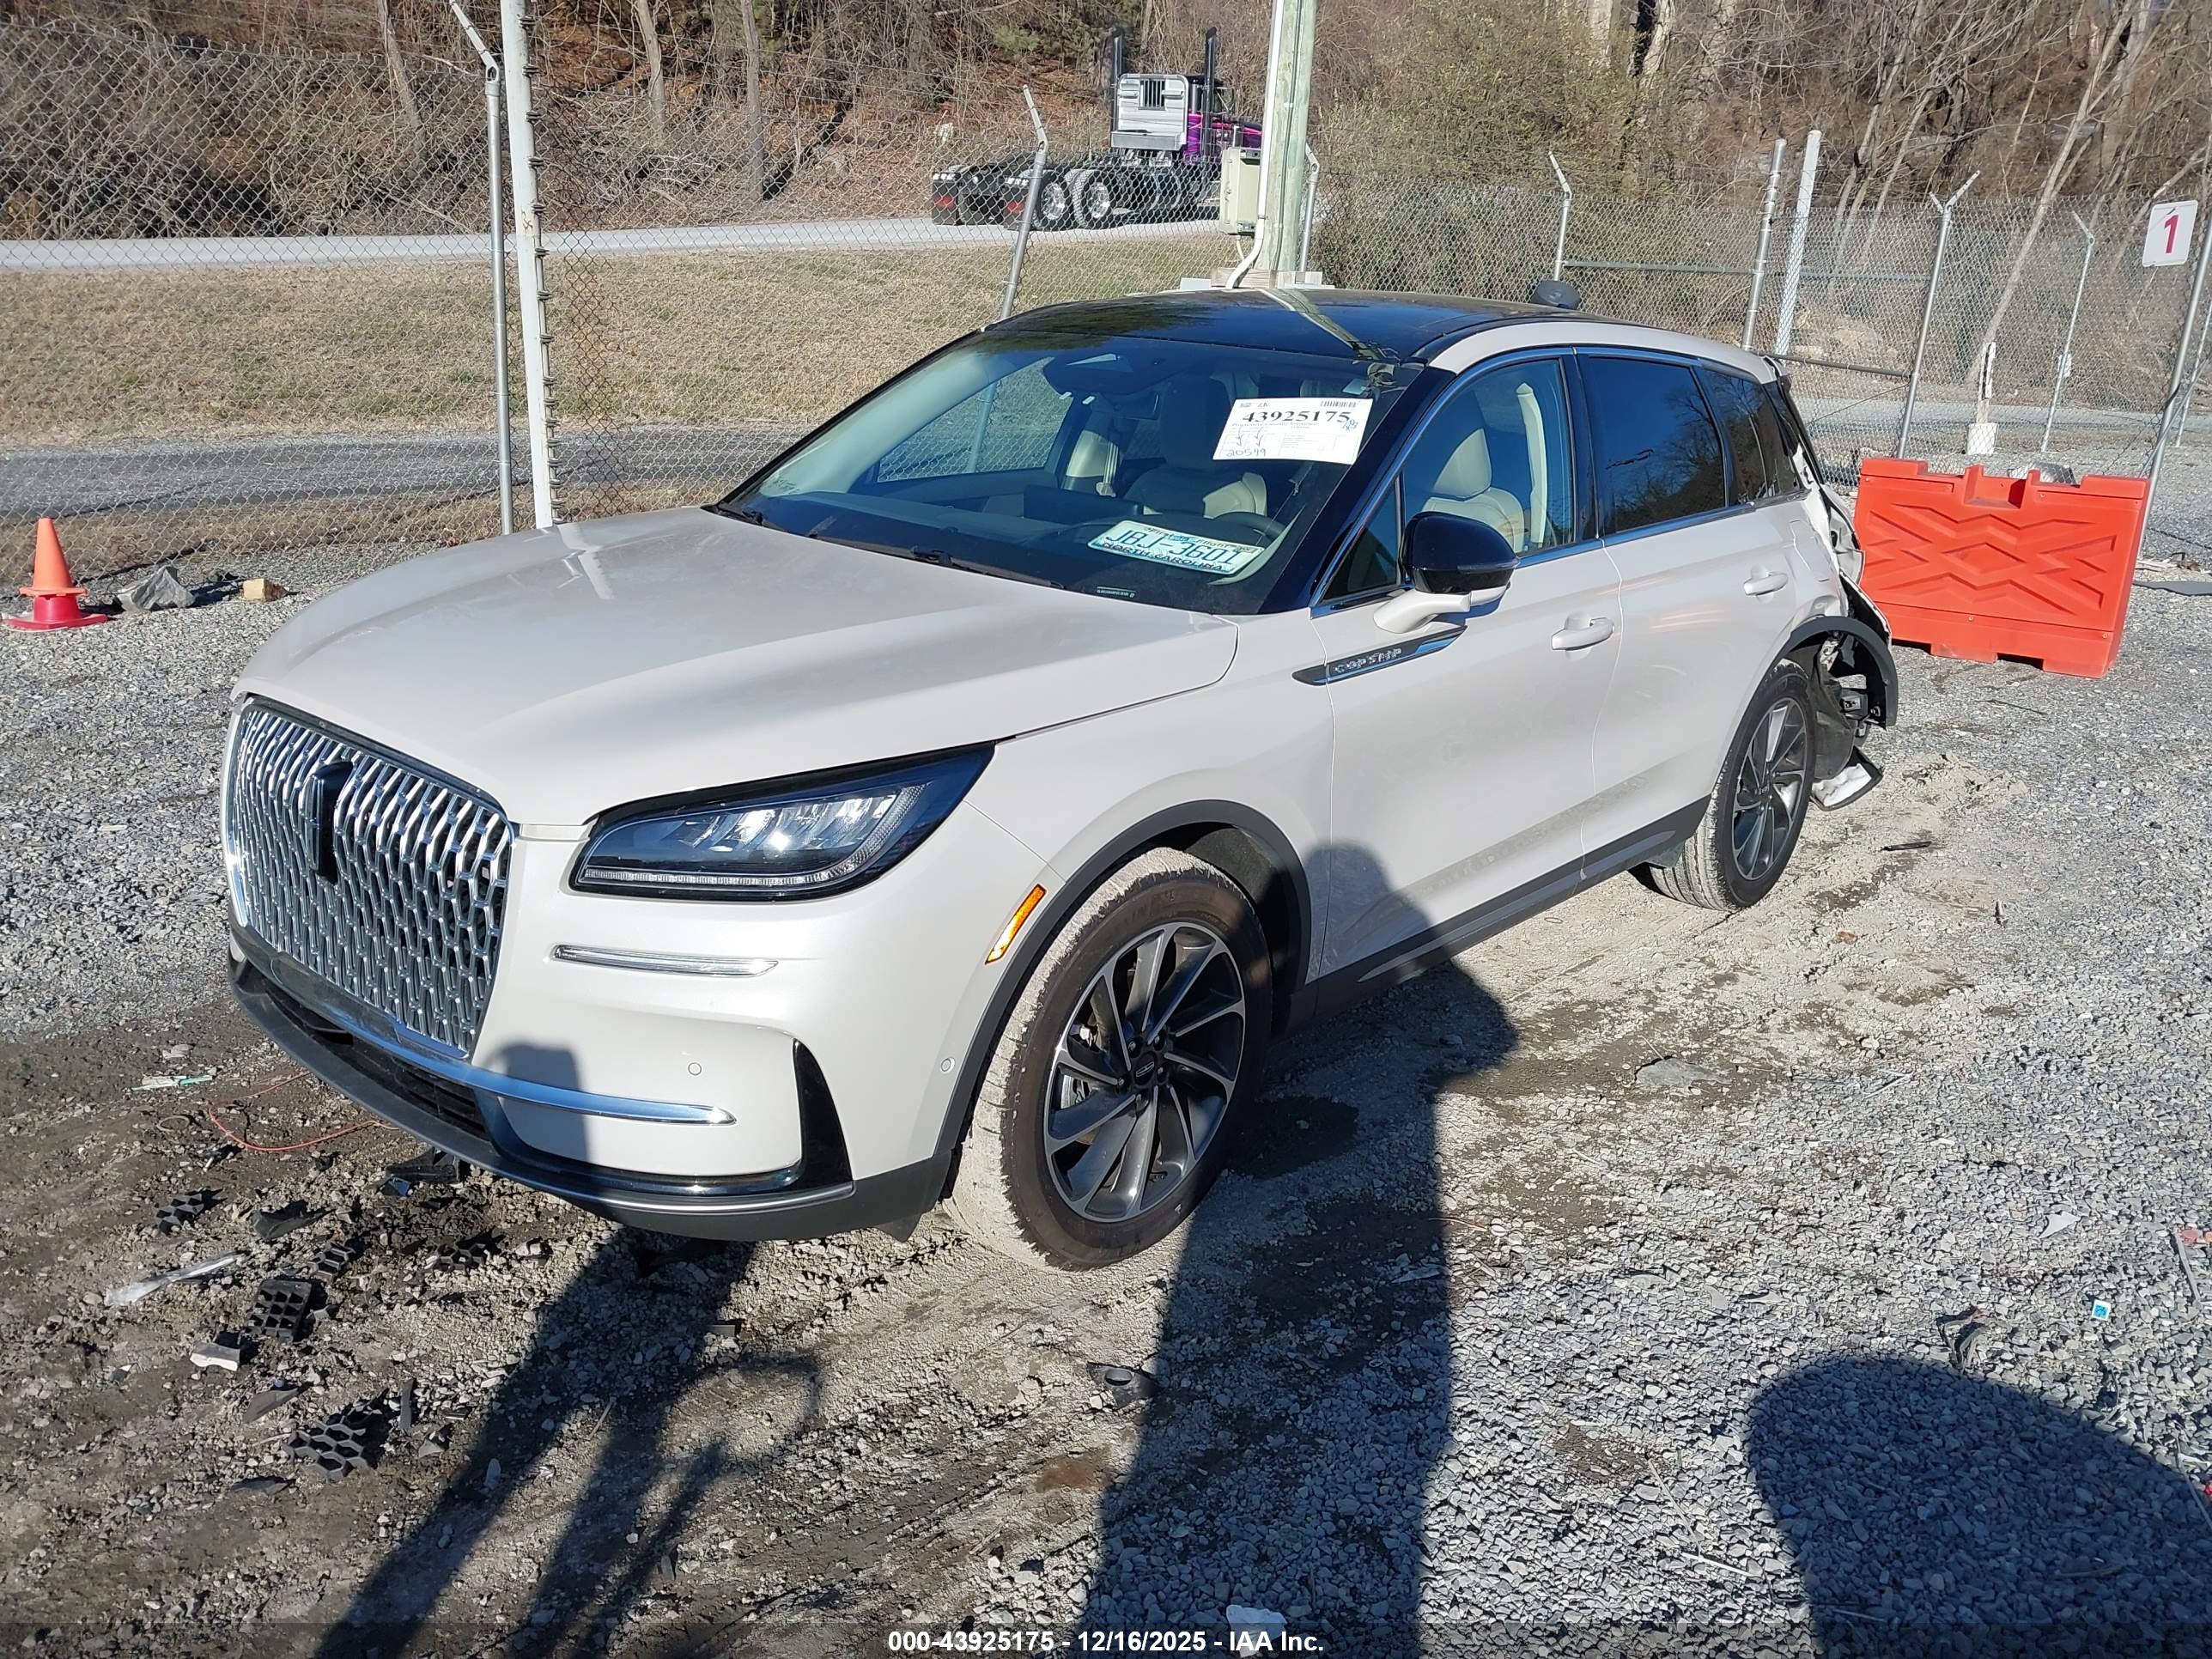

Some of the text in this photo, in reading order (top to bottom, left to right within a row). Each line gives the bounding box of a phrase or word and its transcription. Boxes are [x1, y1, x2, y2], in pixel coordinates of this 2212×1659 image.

[2164, 215, 2179, 253] 1
[1243, 410, 1351, 422] 43925175
[1103, 543, 1222, 570] NORTH CAROLINA
[1106, 530, 1243, 564] JBJ-3601
